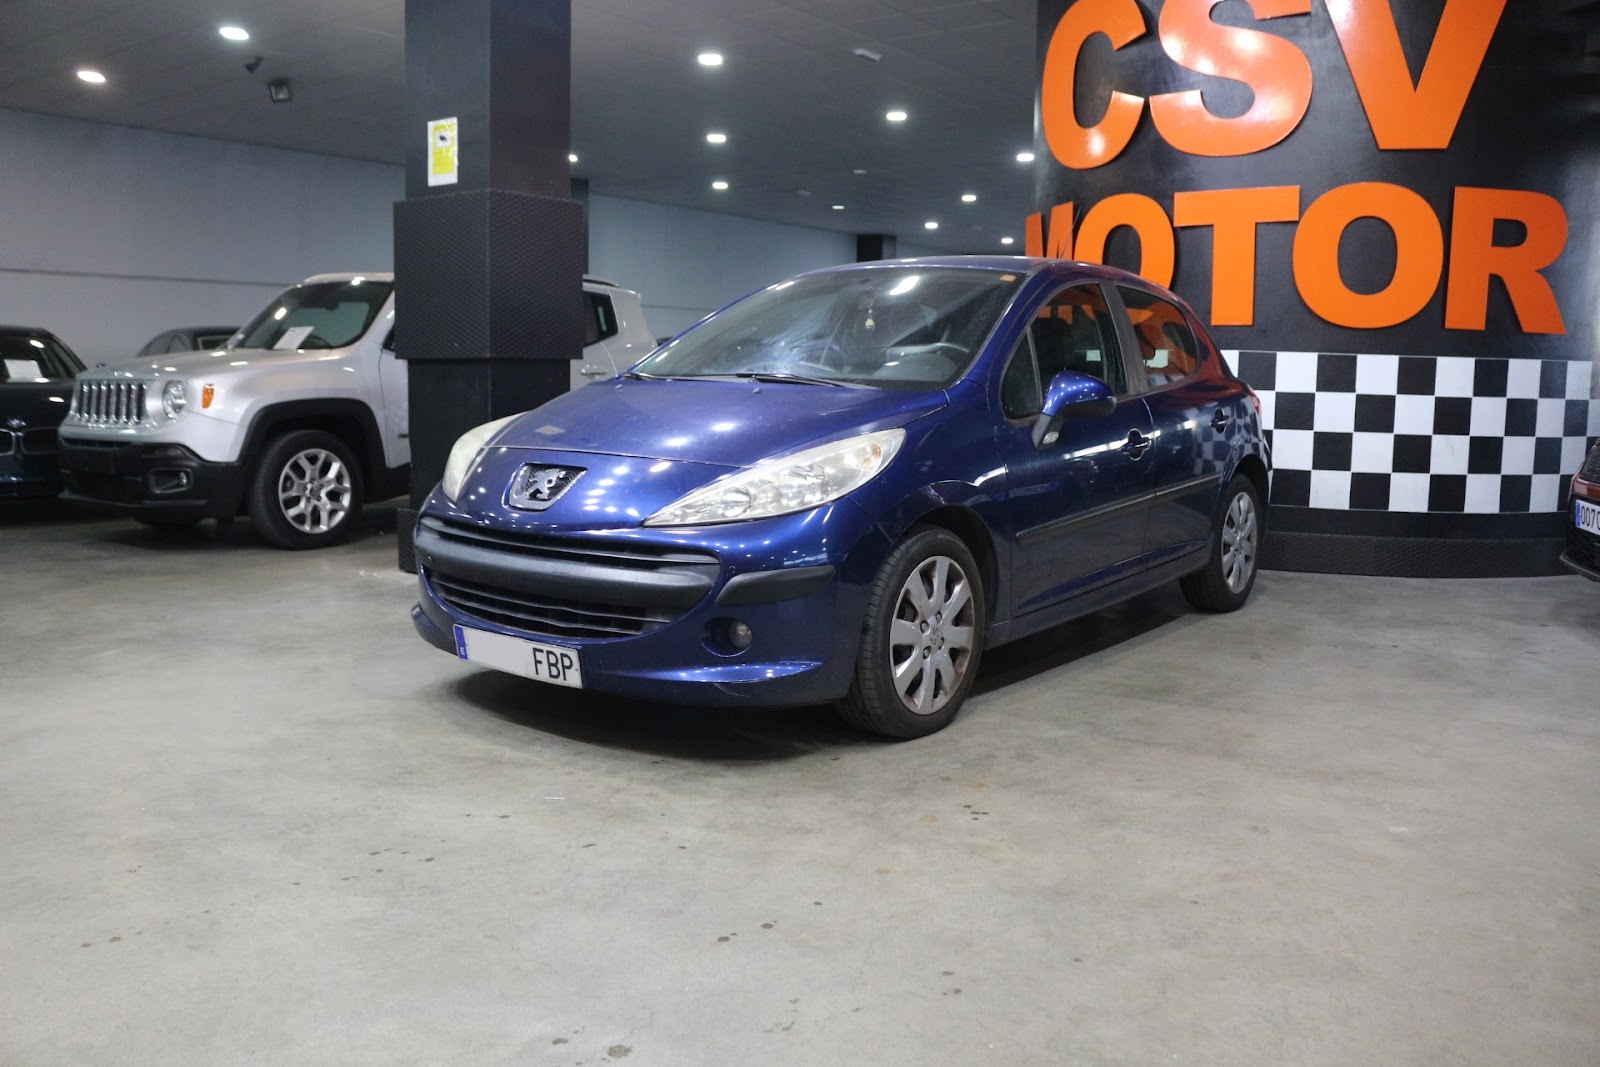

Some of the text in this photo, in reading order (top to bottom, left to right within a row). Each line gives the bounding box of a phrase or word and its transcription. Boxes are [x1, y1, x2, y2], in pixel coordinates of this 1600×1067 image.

[1042, 0, 1507, 169] CSV
[1025, 182, 1568, 334] MOTOR
[532, 647, 573, 681] FBP
